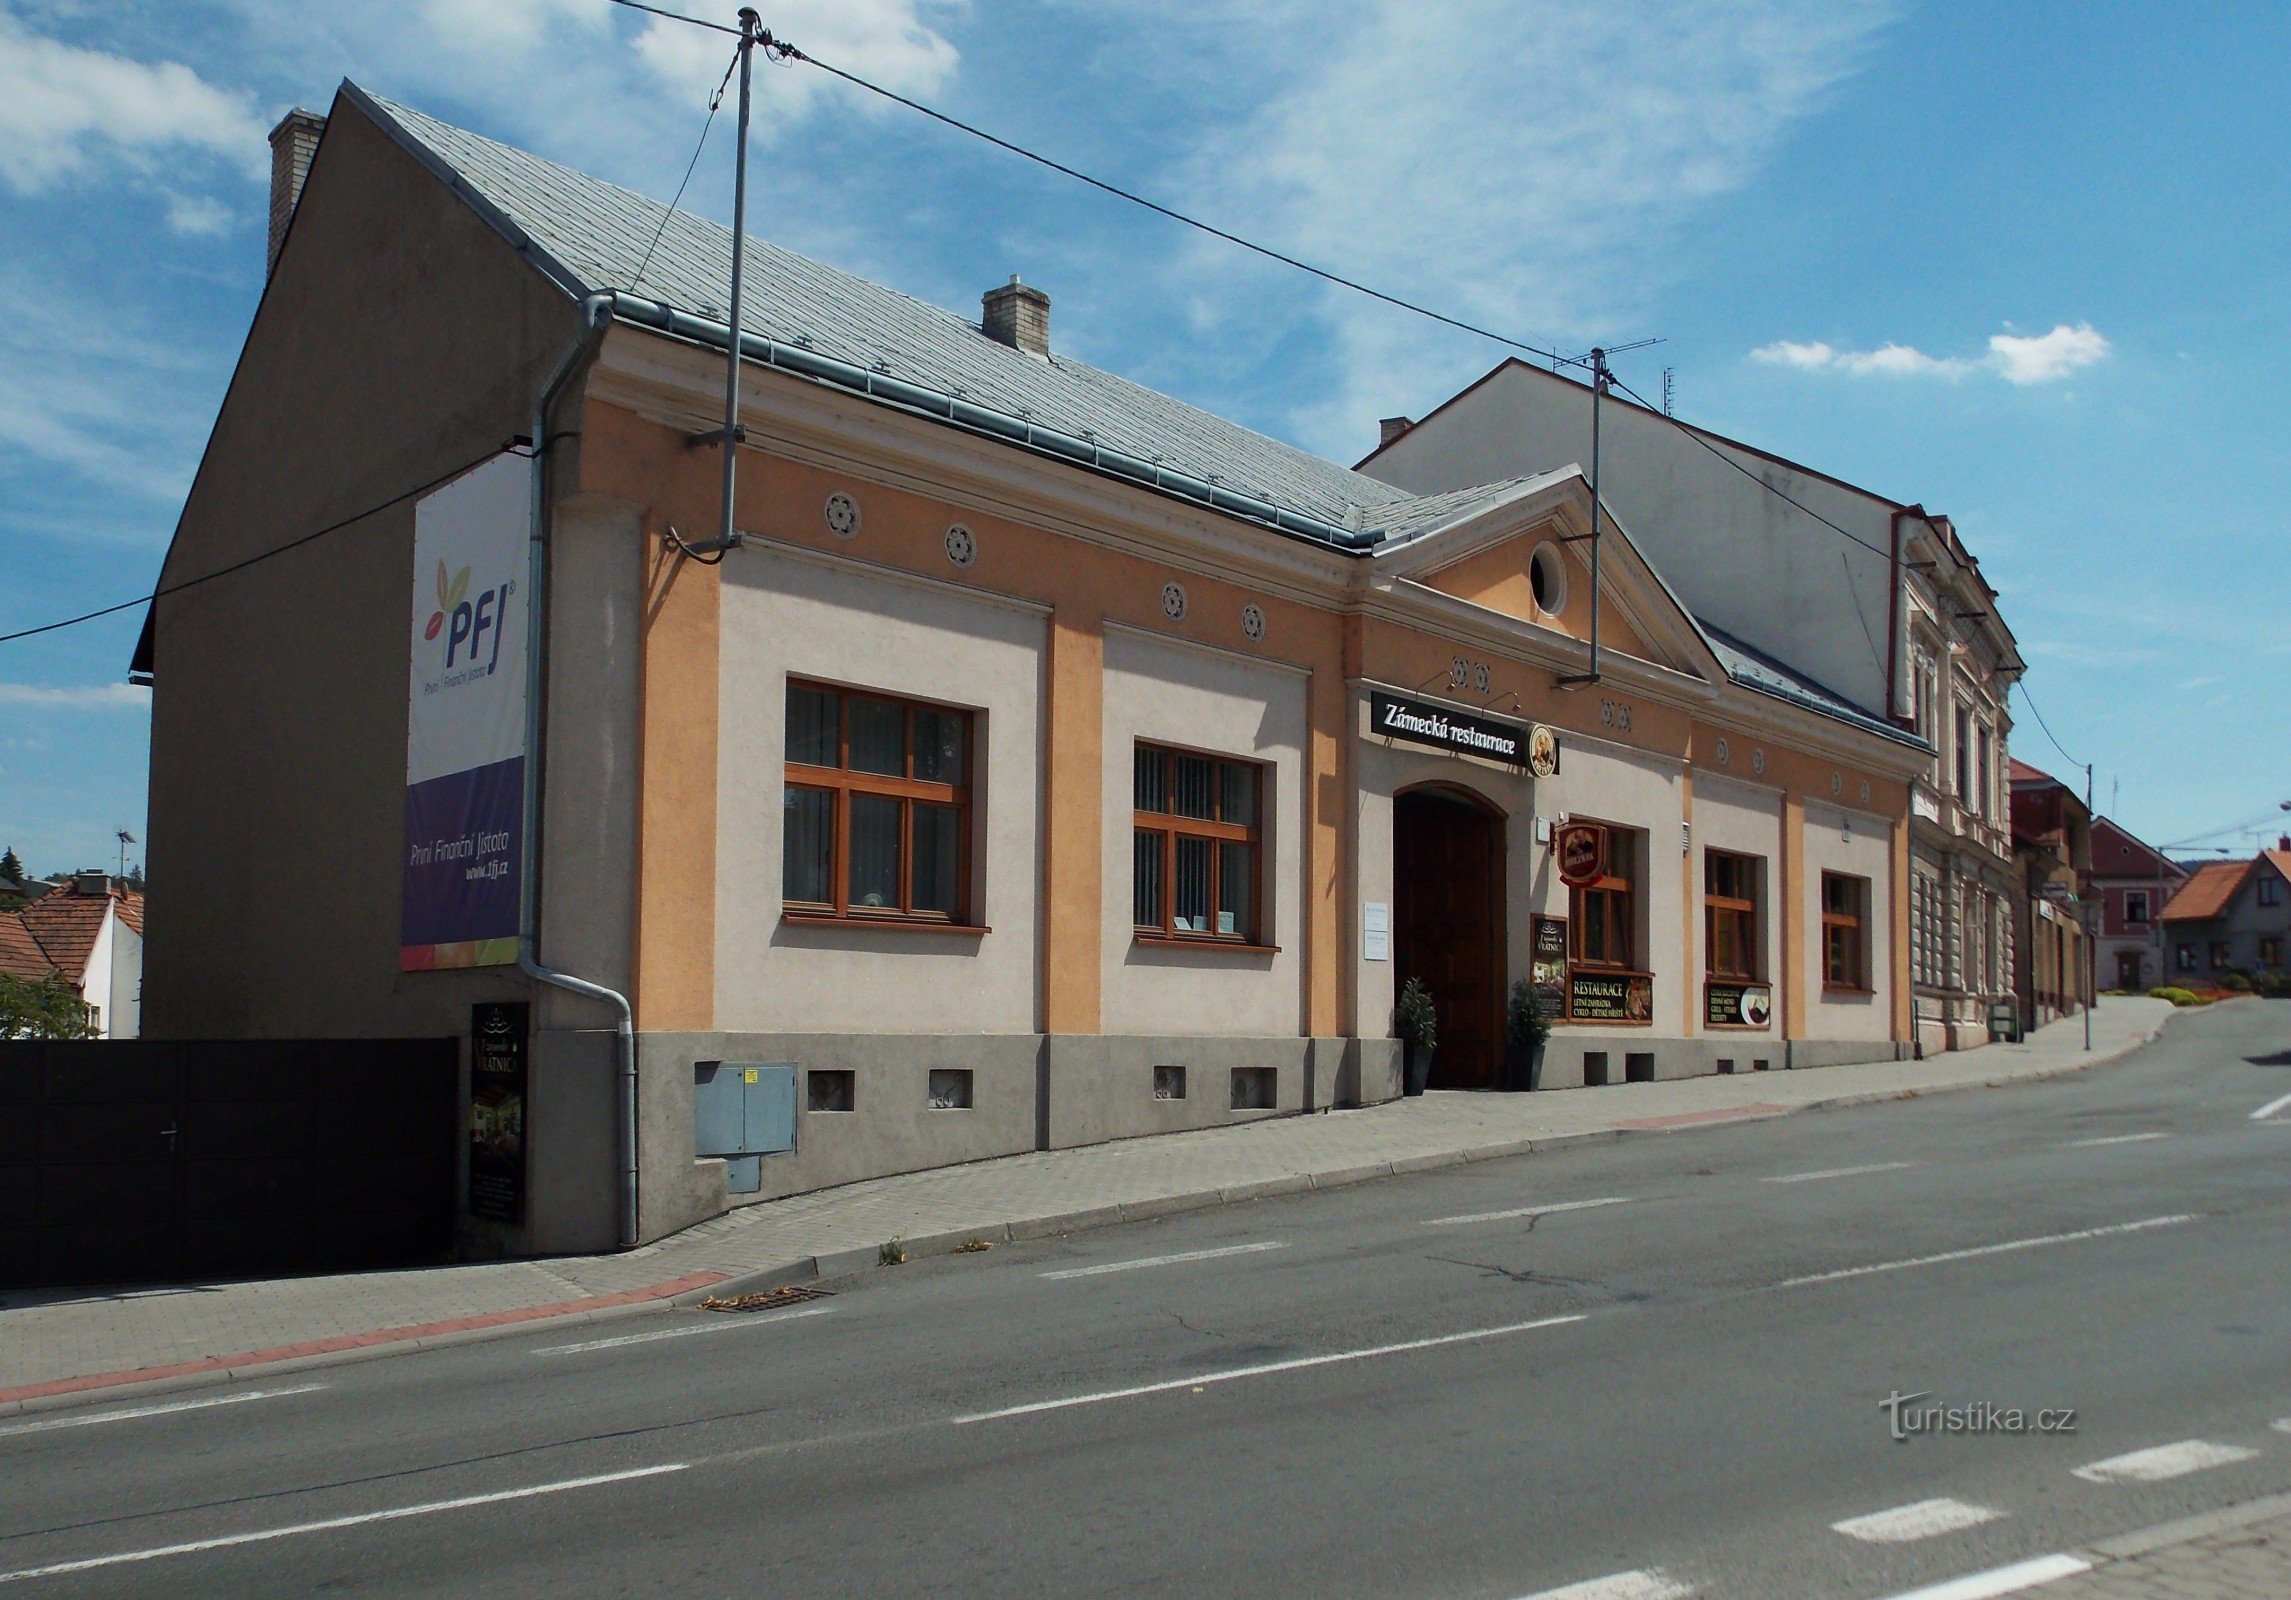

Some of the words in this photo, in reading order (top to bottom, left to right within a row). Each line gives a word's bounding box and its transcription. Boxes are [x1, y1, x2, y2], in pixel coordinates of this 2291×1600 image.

[446, 583, 508, 676] PFJ
[1384, 703, 1448, 739] Zámecká
[1450, 725, 1516, 755] restaurace
[435, 832, 476, 863] Finanční
[476, 829, 509, 860] Jistota
[1574, 981, 1623, 997] RESTAURACE
